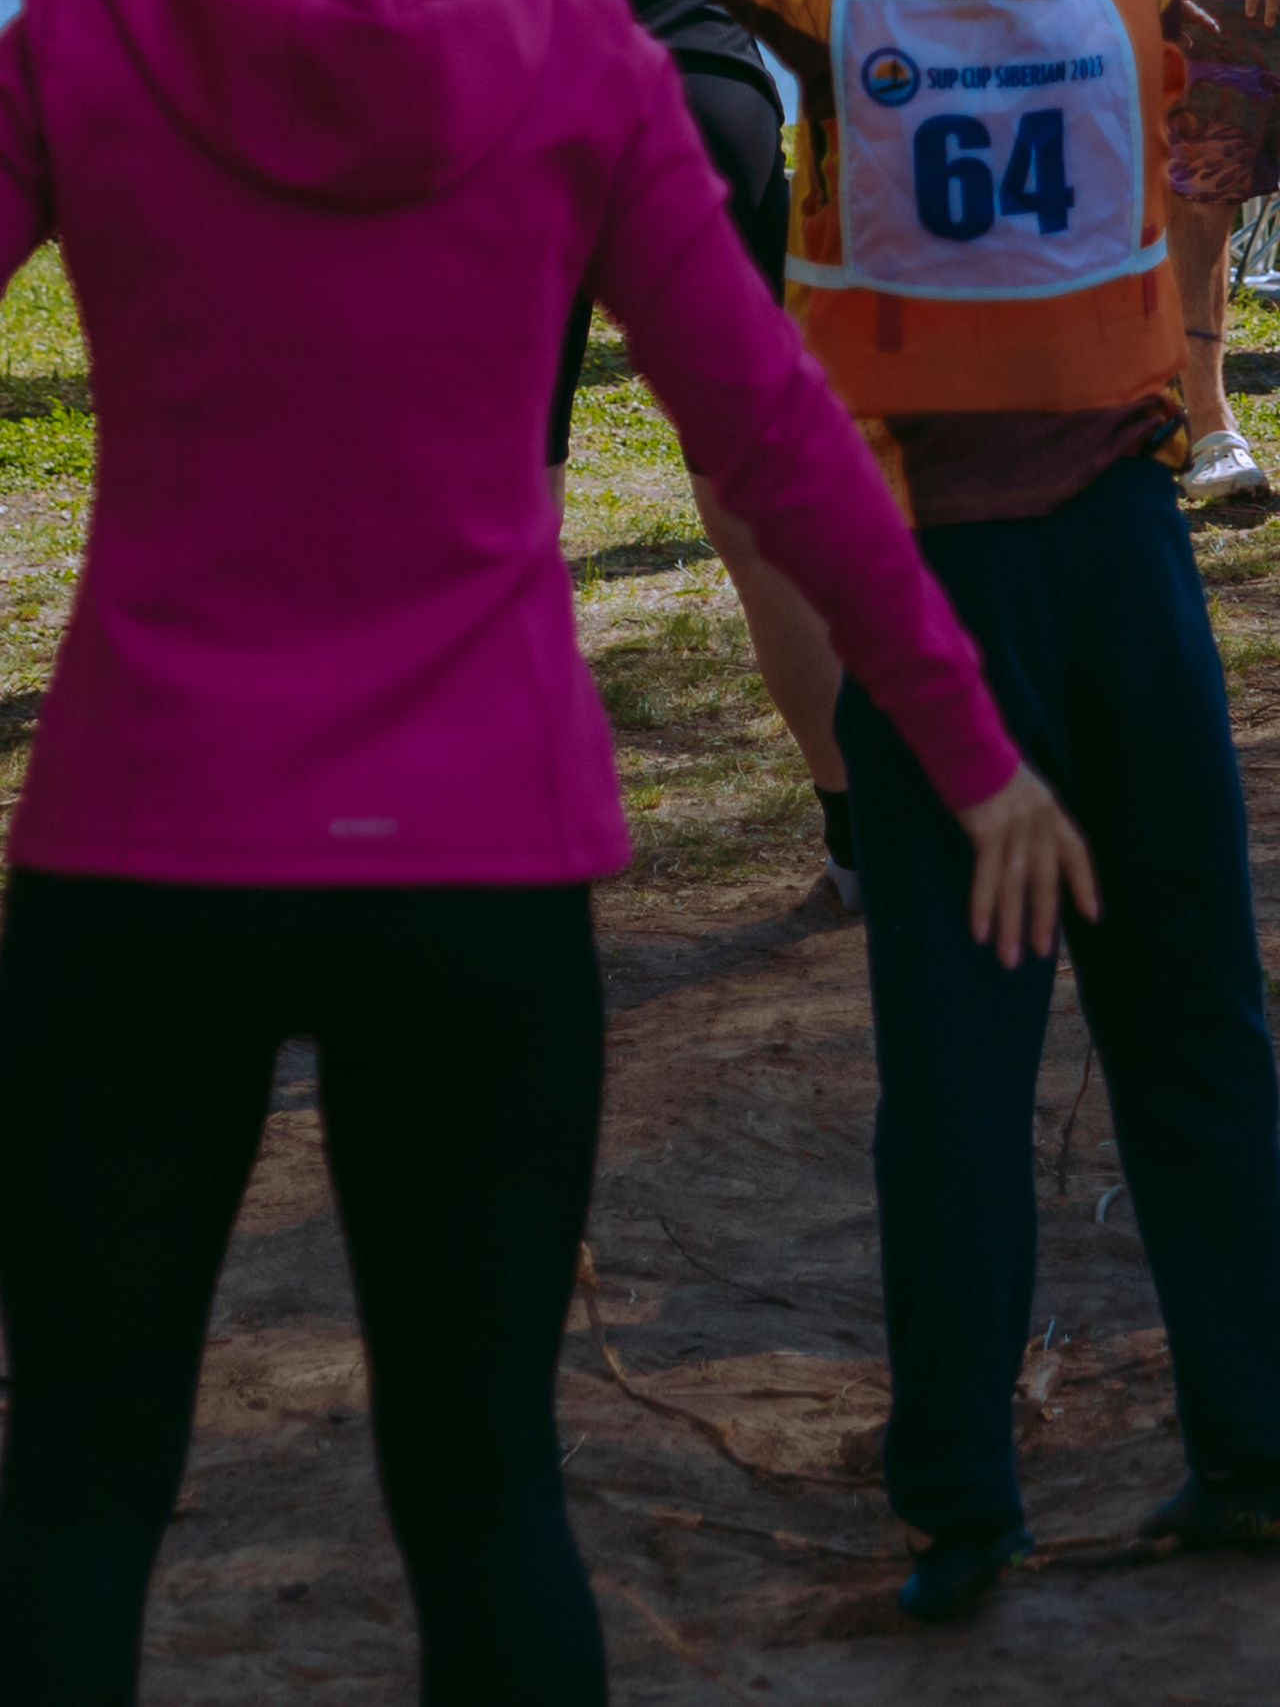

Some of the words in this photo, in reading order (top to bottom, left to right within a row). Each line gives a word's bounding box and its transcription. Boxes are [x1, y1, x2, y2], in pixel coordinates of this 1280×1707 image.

[926, 66, 959, 90] SUP
[960, 65, 992, 90] CUP
[995, 60, 1067, 89] SIBERIAN
[1070, 54, 1104, 82] 2023
[912, 107, 1076, 243] 64
